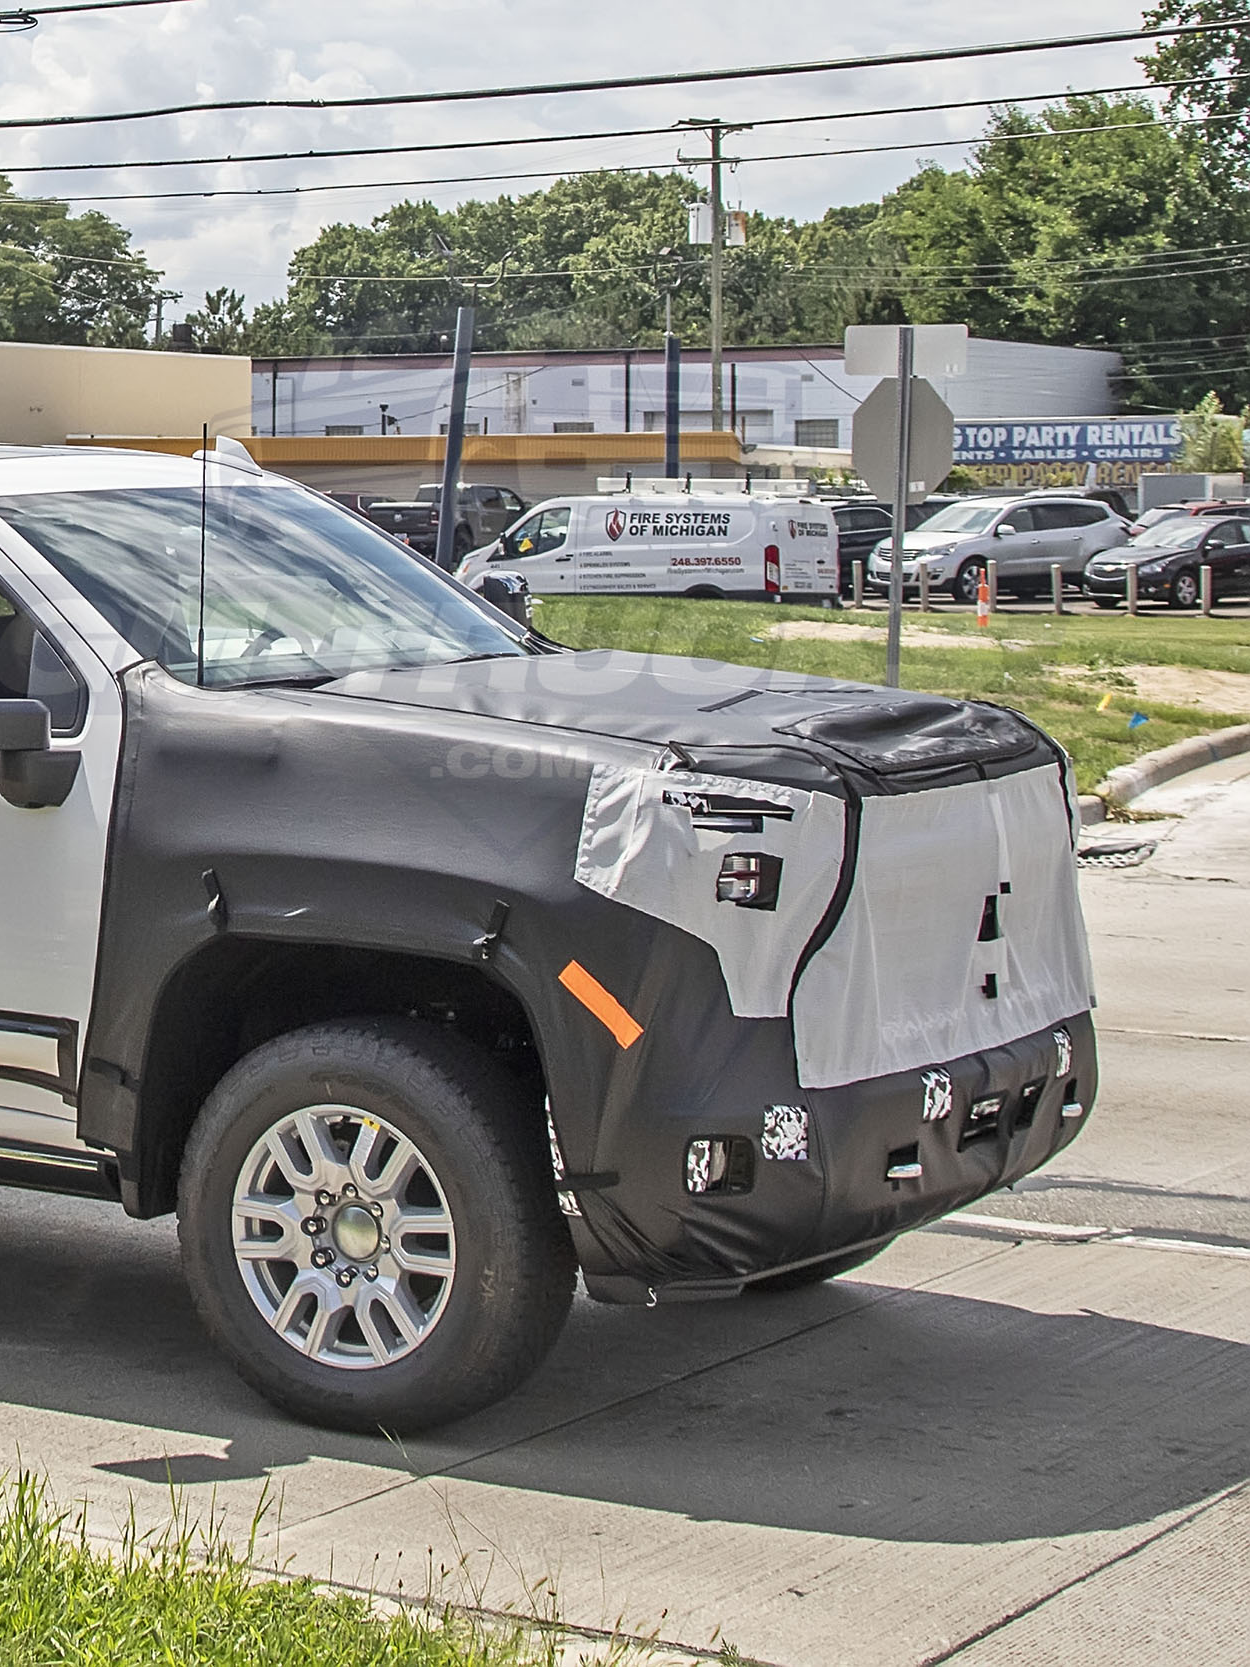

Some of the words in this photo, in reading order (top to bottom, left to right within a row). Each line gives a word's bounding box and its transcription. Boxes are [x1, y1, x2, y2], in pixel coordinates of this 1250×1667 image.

[967, 426, 1007, 447] TOP
[1013, 425, 1080, 447] PARTY
[1087, 424, 1182, 446] RENTALS
[952, 450, 995, 460] ENTS
[1013, 449, 1076, 459] TABLES
[1094, 448, 1163, 459] CHAIRS
[629, 513, 660, 524] FIRE
[665, 513, 731, 524] SYSTEMS
[629, 525, 648, 536] OF
[652, 525, 729, 537] MICHIGAN
[670, 556, 741, 567] 248.397.6550
